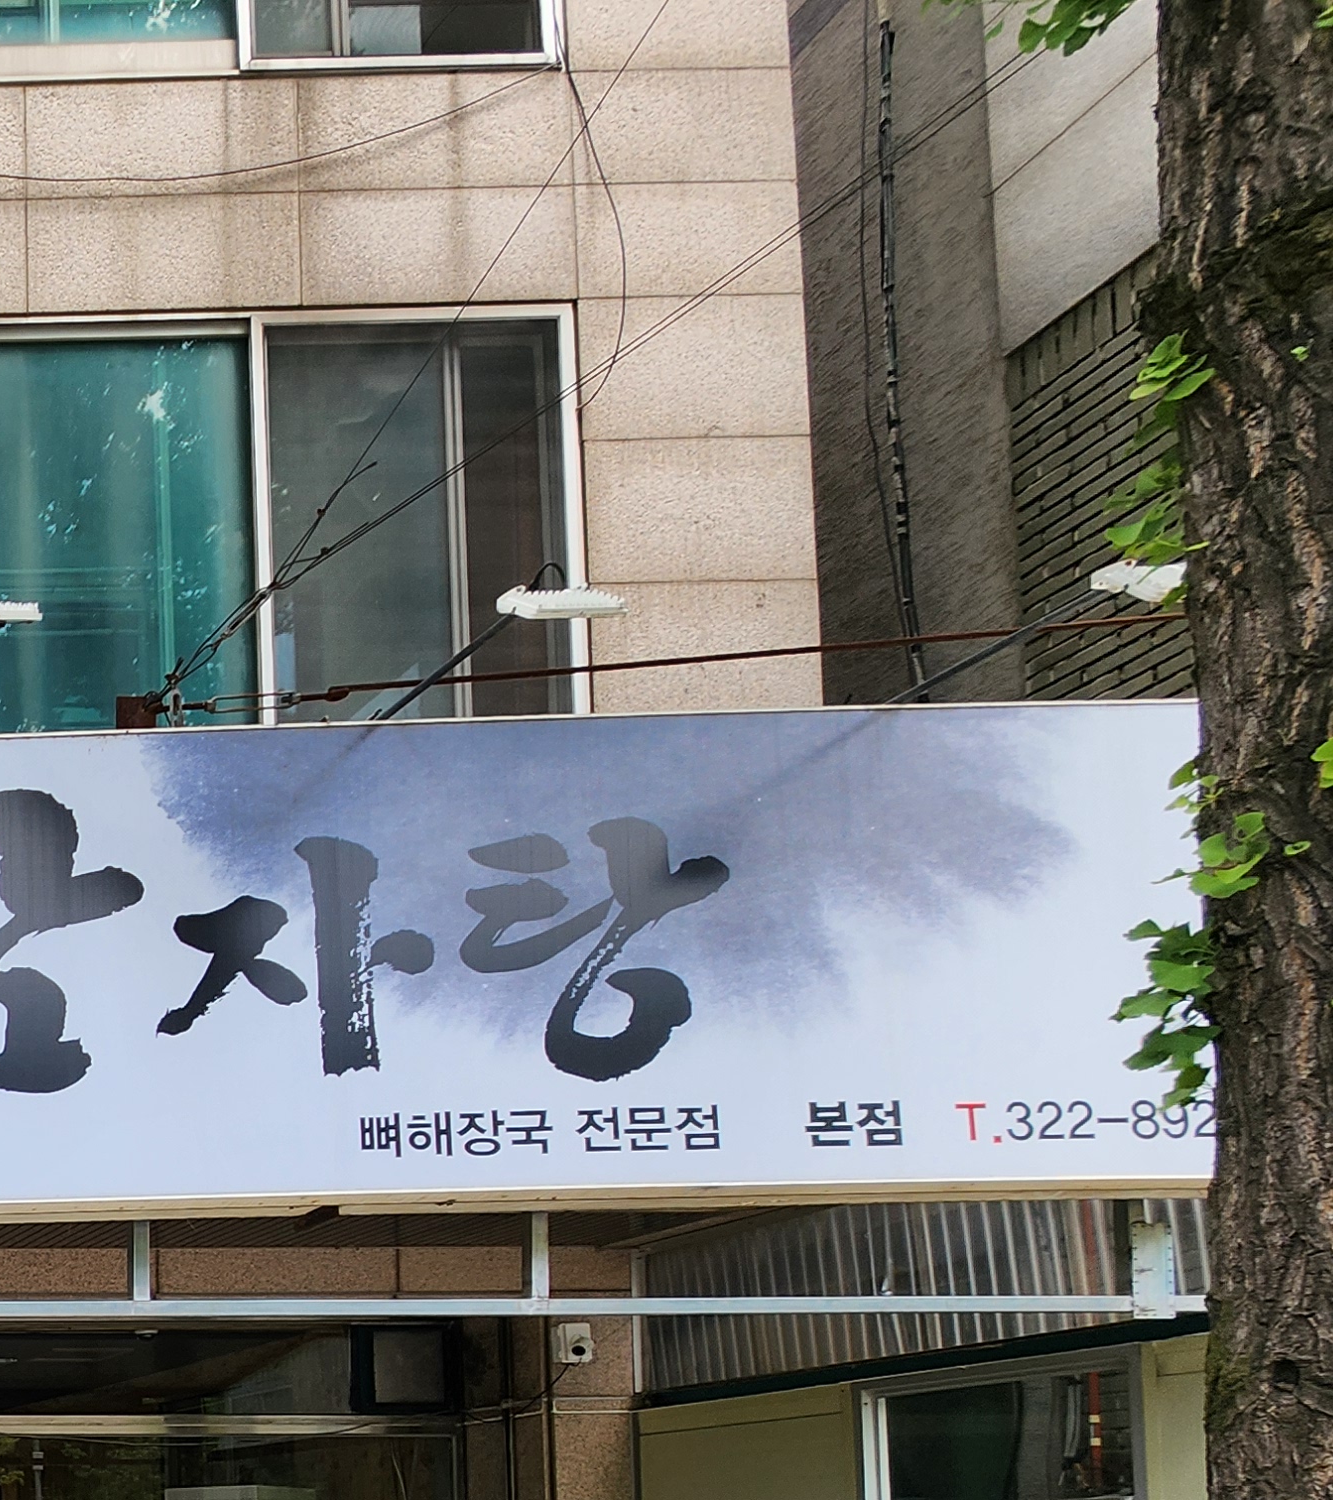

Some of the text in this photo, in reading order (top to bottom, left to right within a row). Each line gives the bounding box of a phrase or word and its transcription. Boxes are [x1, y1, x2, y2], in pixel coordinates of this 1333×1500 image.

[360, 1110, 553, 1158] 뼈해장국
[576, 1104, 721, 1152] 전문점
[805, 1100, 904, 1147] 본점
